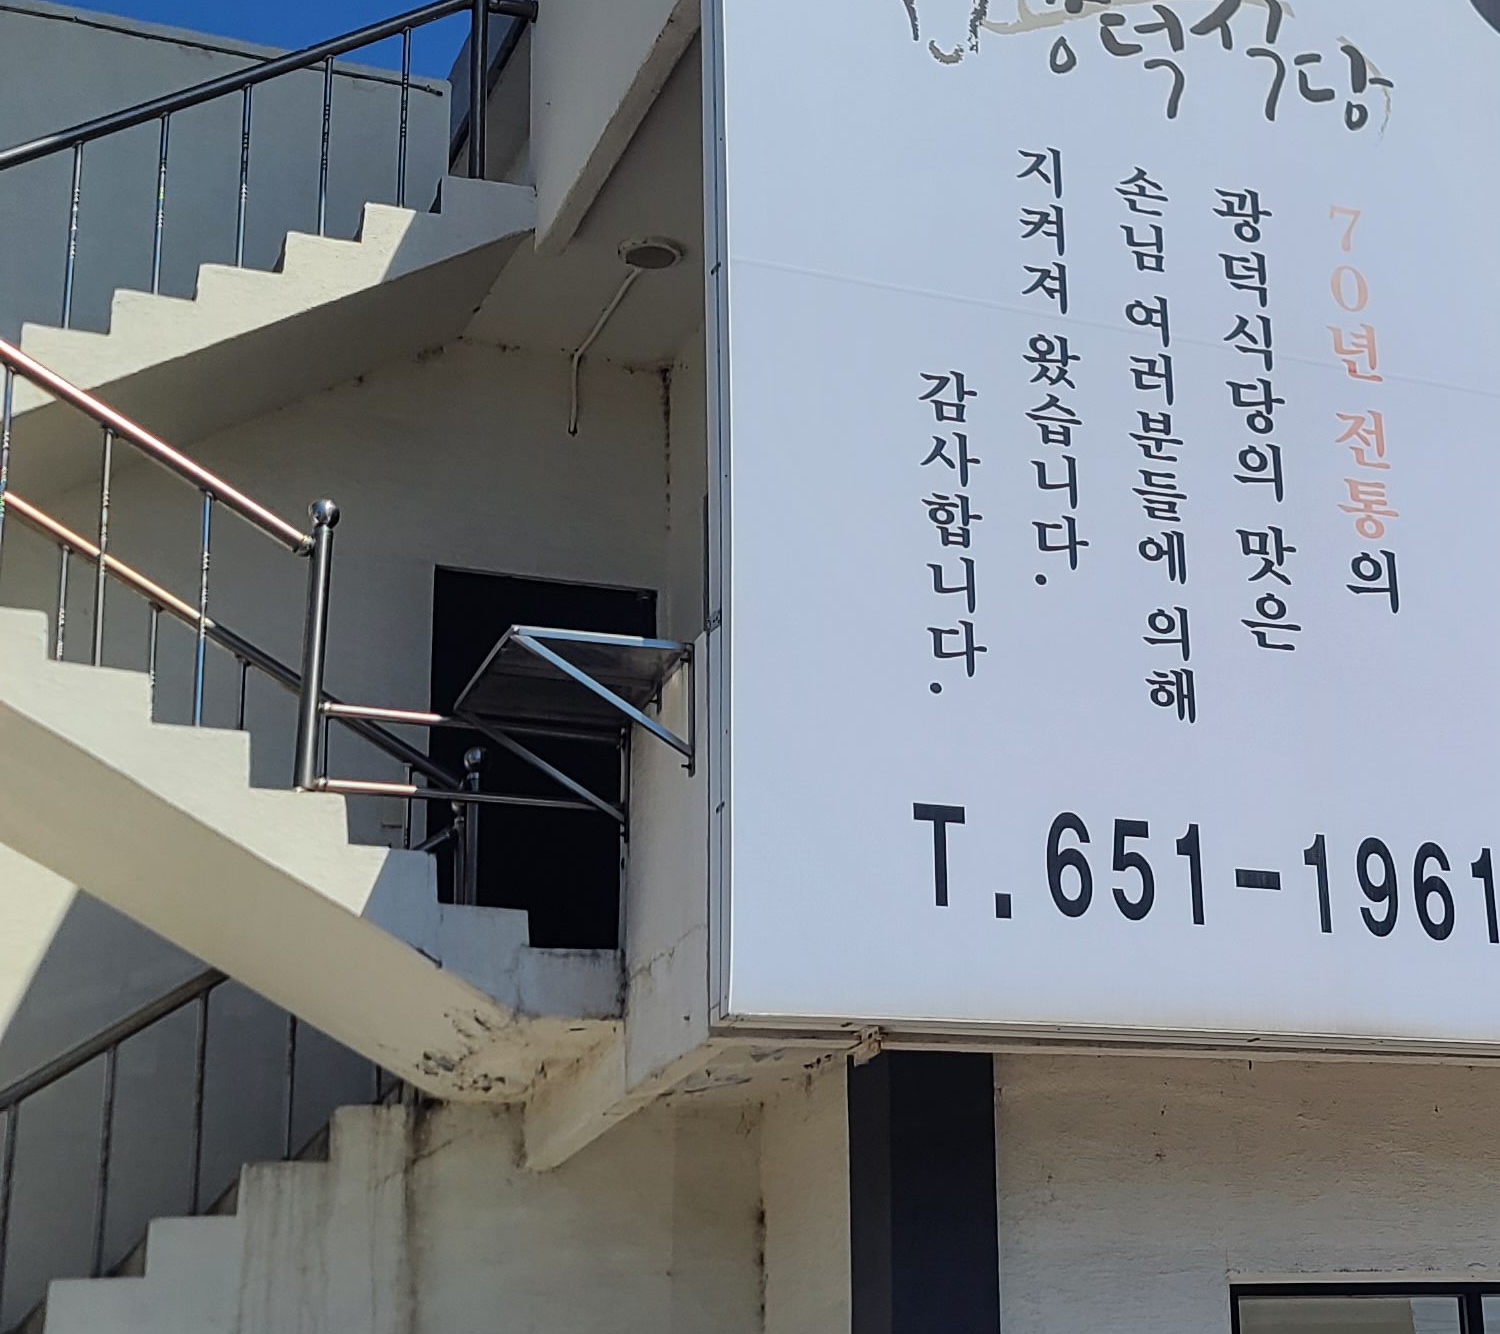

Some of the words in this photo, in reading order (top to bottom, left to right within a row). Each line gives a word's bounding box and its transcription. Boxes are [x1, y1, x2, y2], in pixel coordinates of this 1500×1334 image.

[1114, 166, 1169, 273] 손님
[1325, 205, 1384, 383] 70년
[1124, 296, 1188, 584] 여러분들에
[1212, 188, 1286, 503] 광덕식당의
[917, 370, 987, 695] 감사합니다.
[1235, 526, 1302, 651] 맛은
[1333, 410, 1400, 613] 전통의
[1142, 606, 1197, 723] 의해
